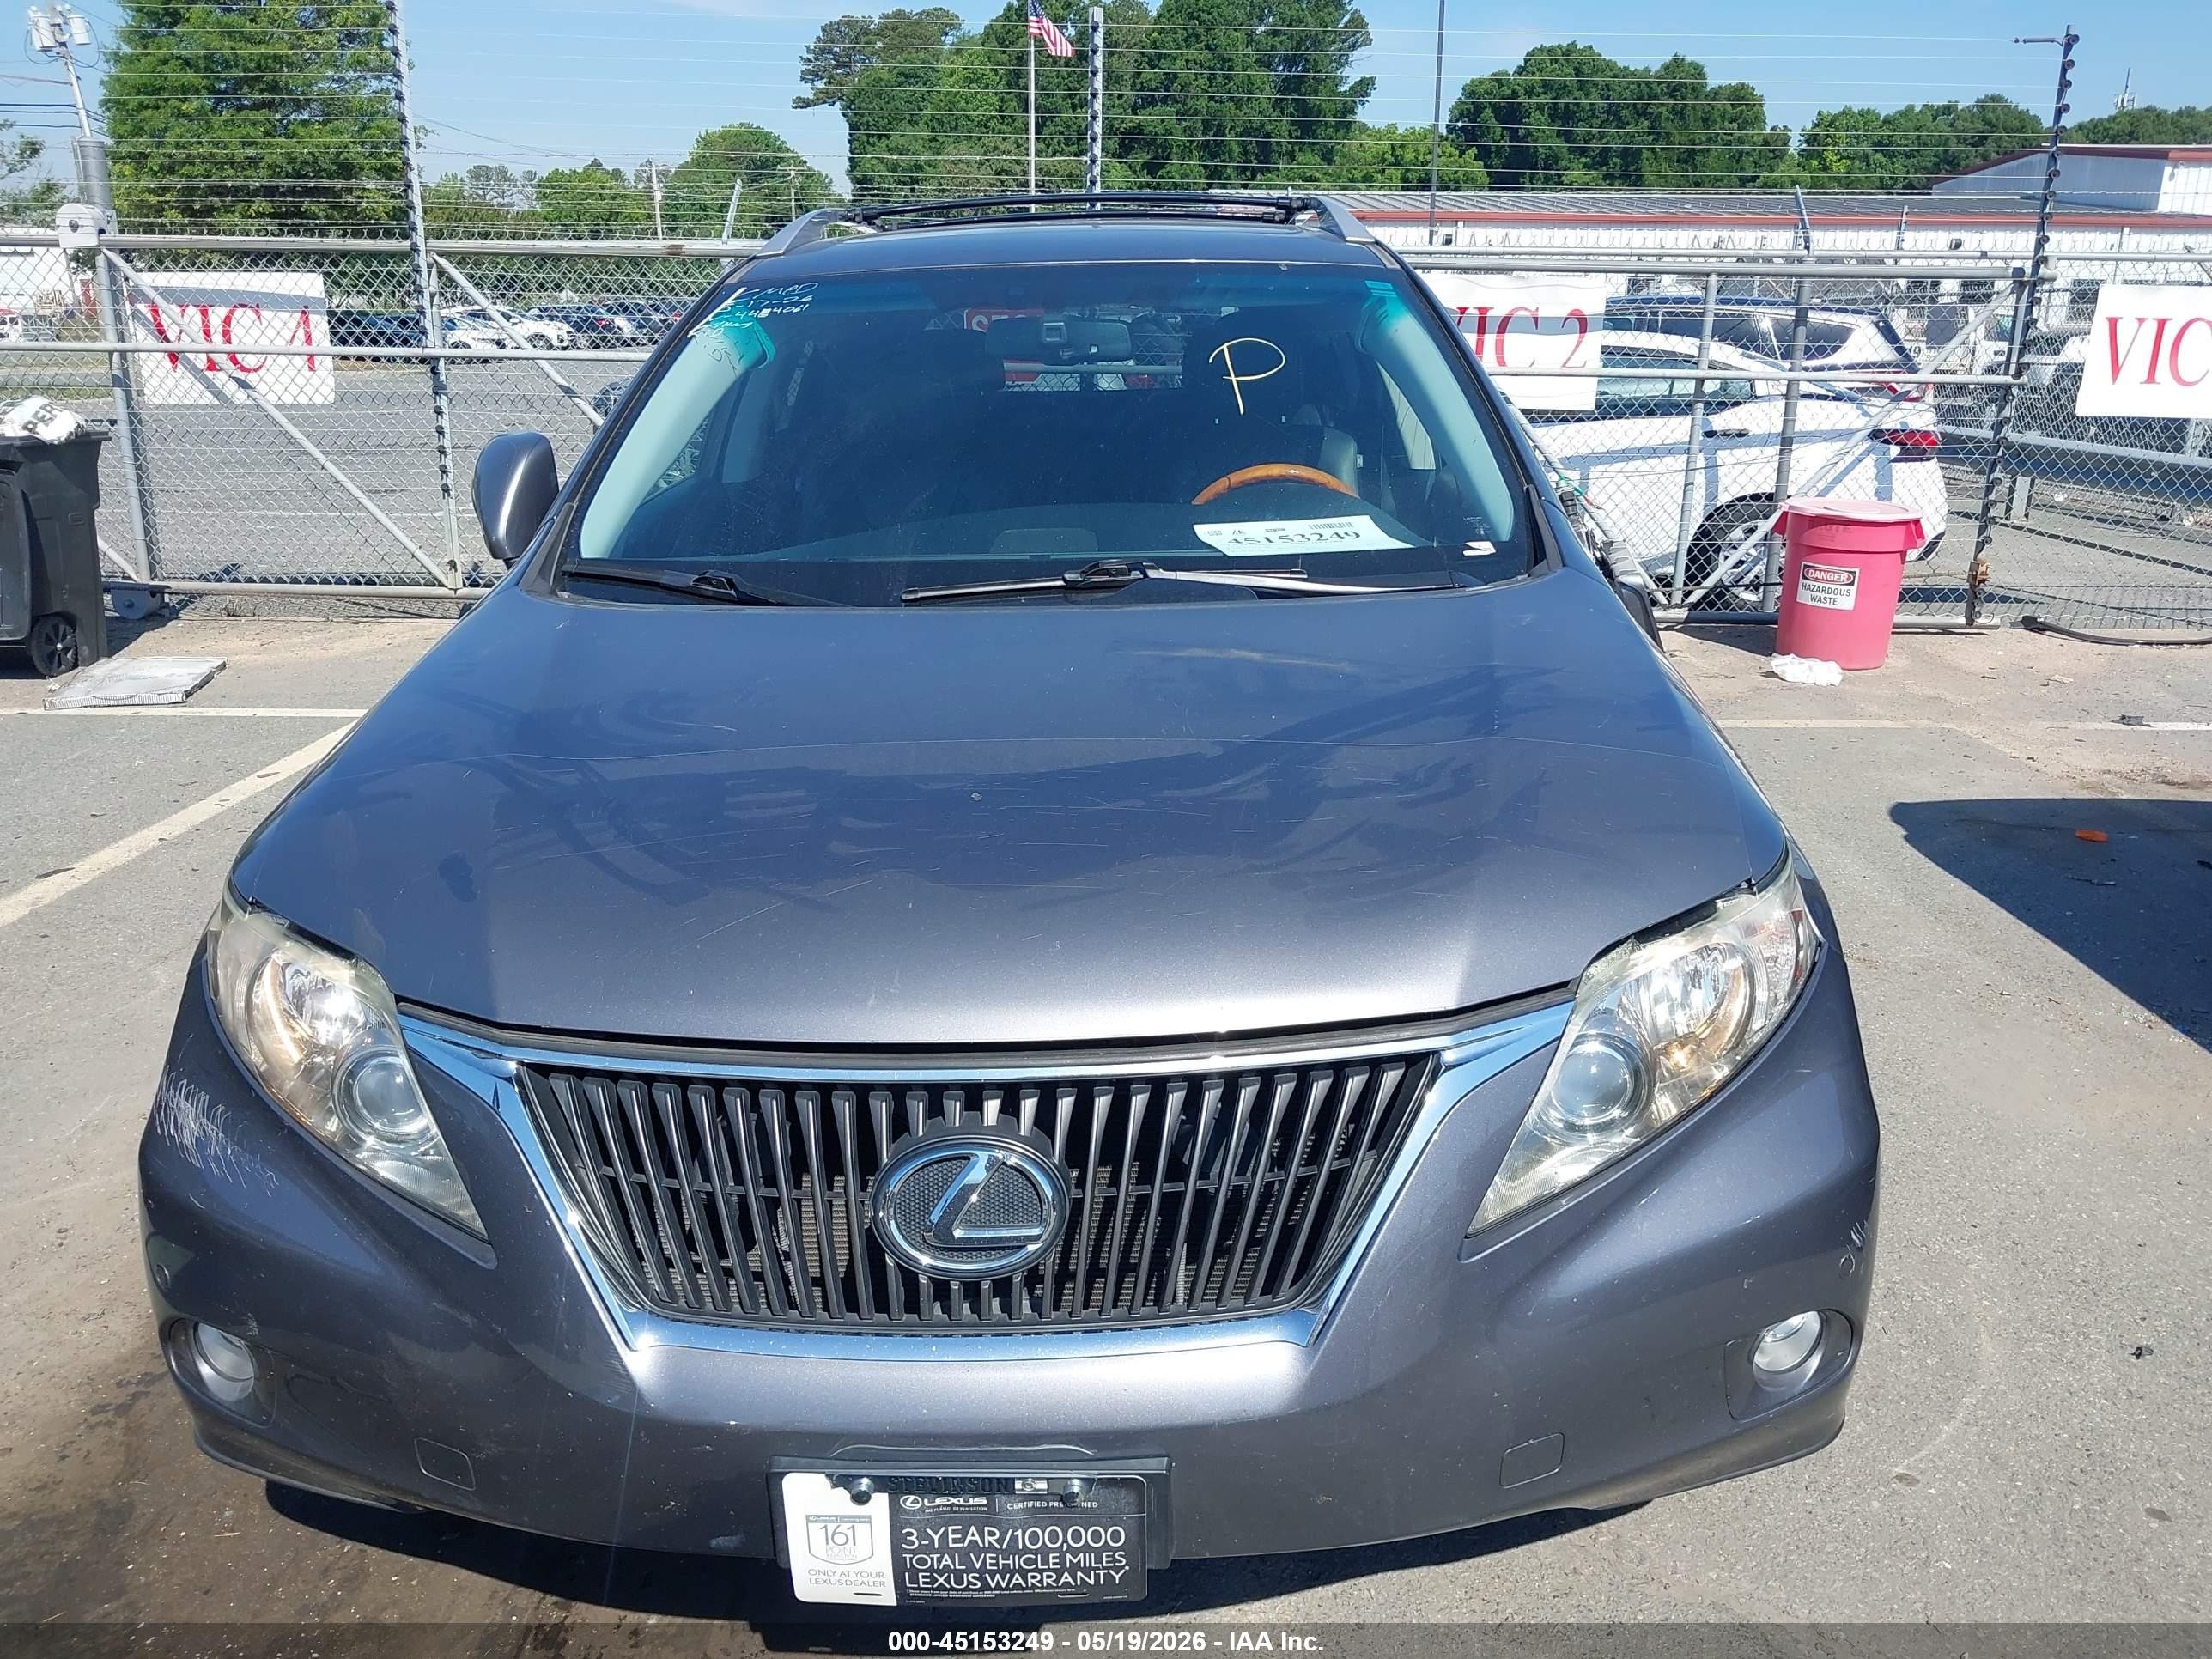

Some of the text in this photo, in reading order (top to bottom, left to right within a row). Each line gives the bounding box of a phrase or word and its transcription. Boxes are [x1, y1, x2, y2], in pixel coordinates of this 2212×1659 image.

[145, 302, 268, 374] VIC
[1560, 307, 1589, 368] 2
[2106, 316, 2212, 386] VIC
[1208, 337, 1286, 416] P
[1808, 568, 1849, 582] DANGER
[1801, 582, 1851, 597] HAZARDOUS
[1809, 593, 1839, 606] WASTE
[923, 1496, 988, 1506] LEXUS
[1006, 1500, 1048, 1510] CERTIFIED
[819, 1524, 856, 1547] 161
[901, 1524, 1126, 1551] 3-YEAR/100,000
[825, 1546, 857, 1554] POINT
[902, 1551, 1127, 1571] TOTAL VEHICLE MILES
[807, 1568, 885, 1579] ONLY AT YOUR
[809, 1577, 886, 1588] LEXUS DEALER
[904, 1571, 981, 1589] LEXUS
